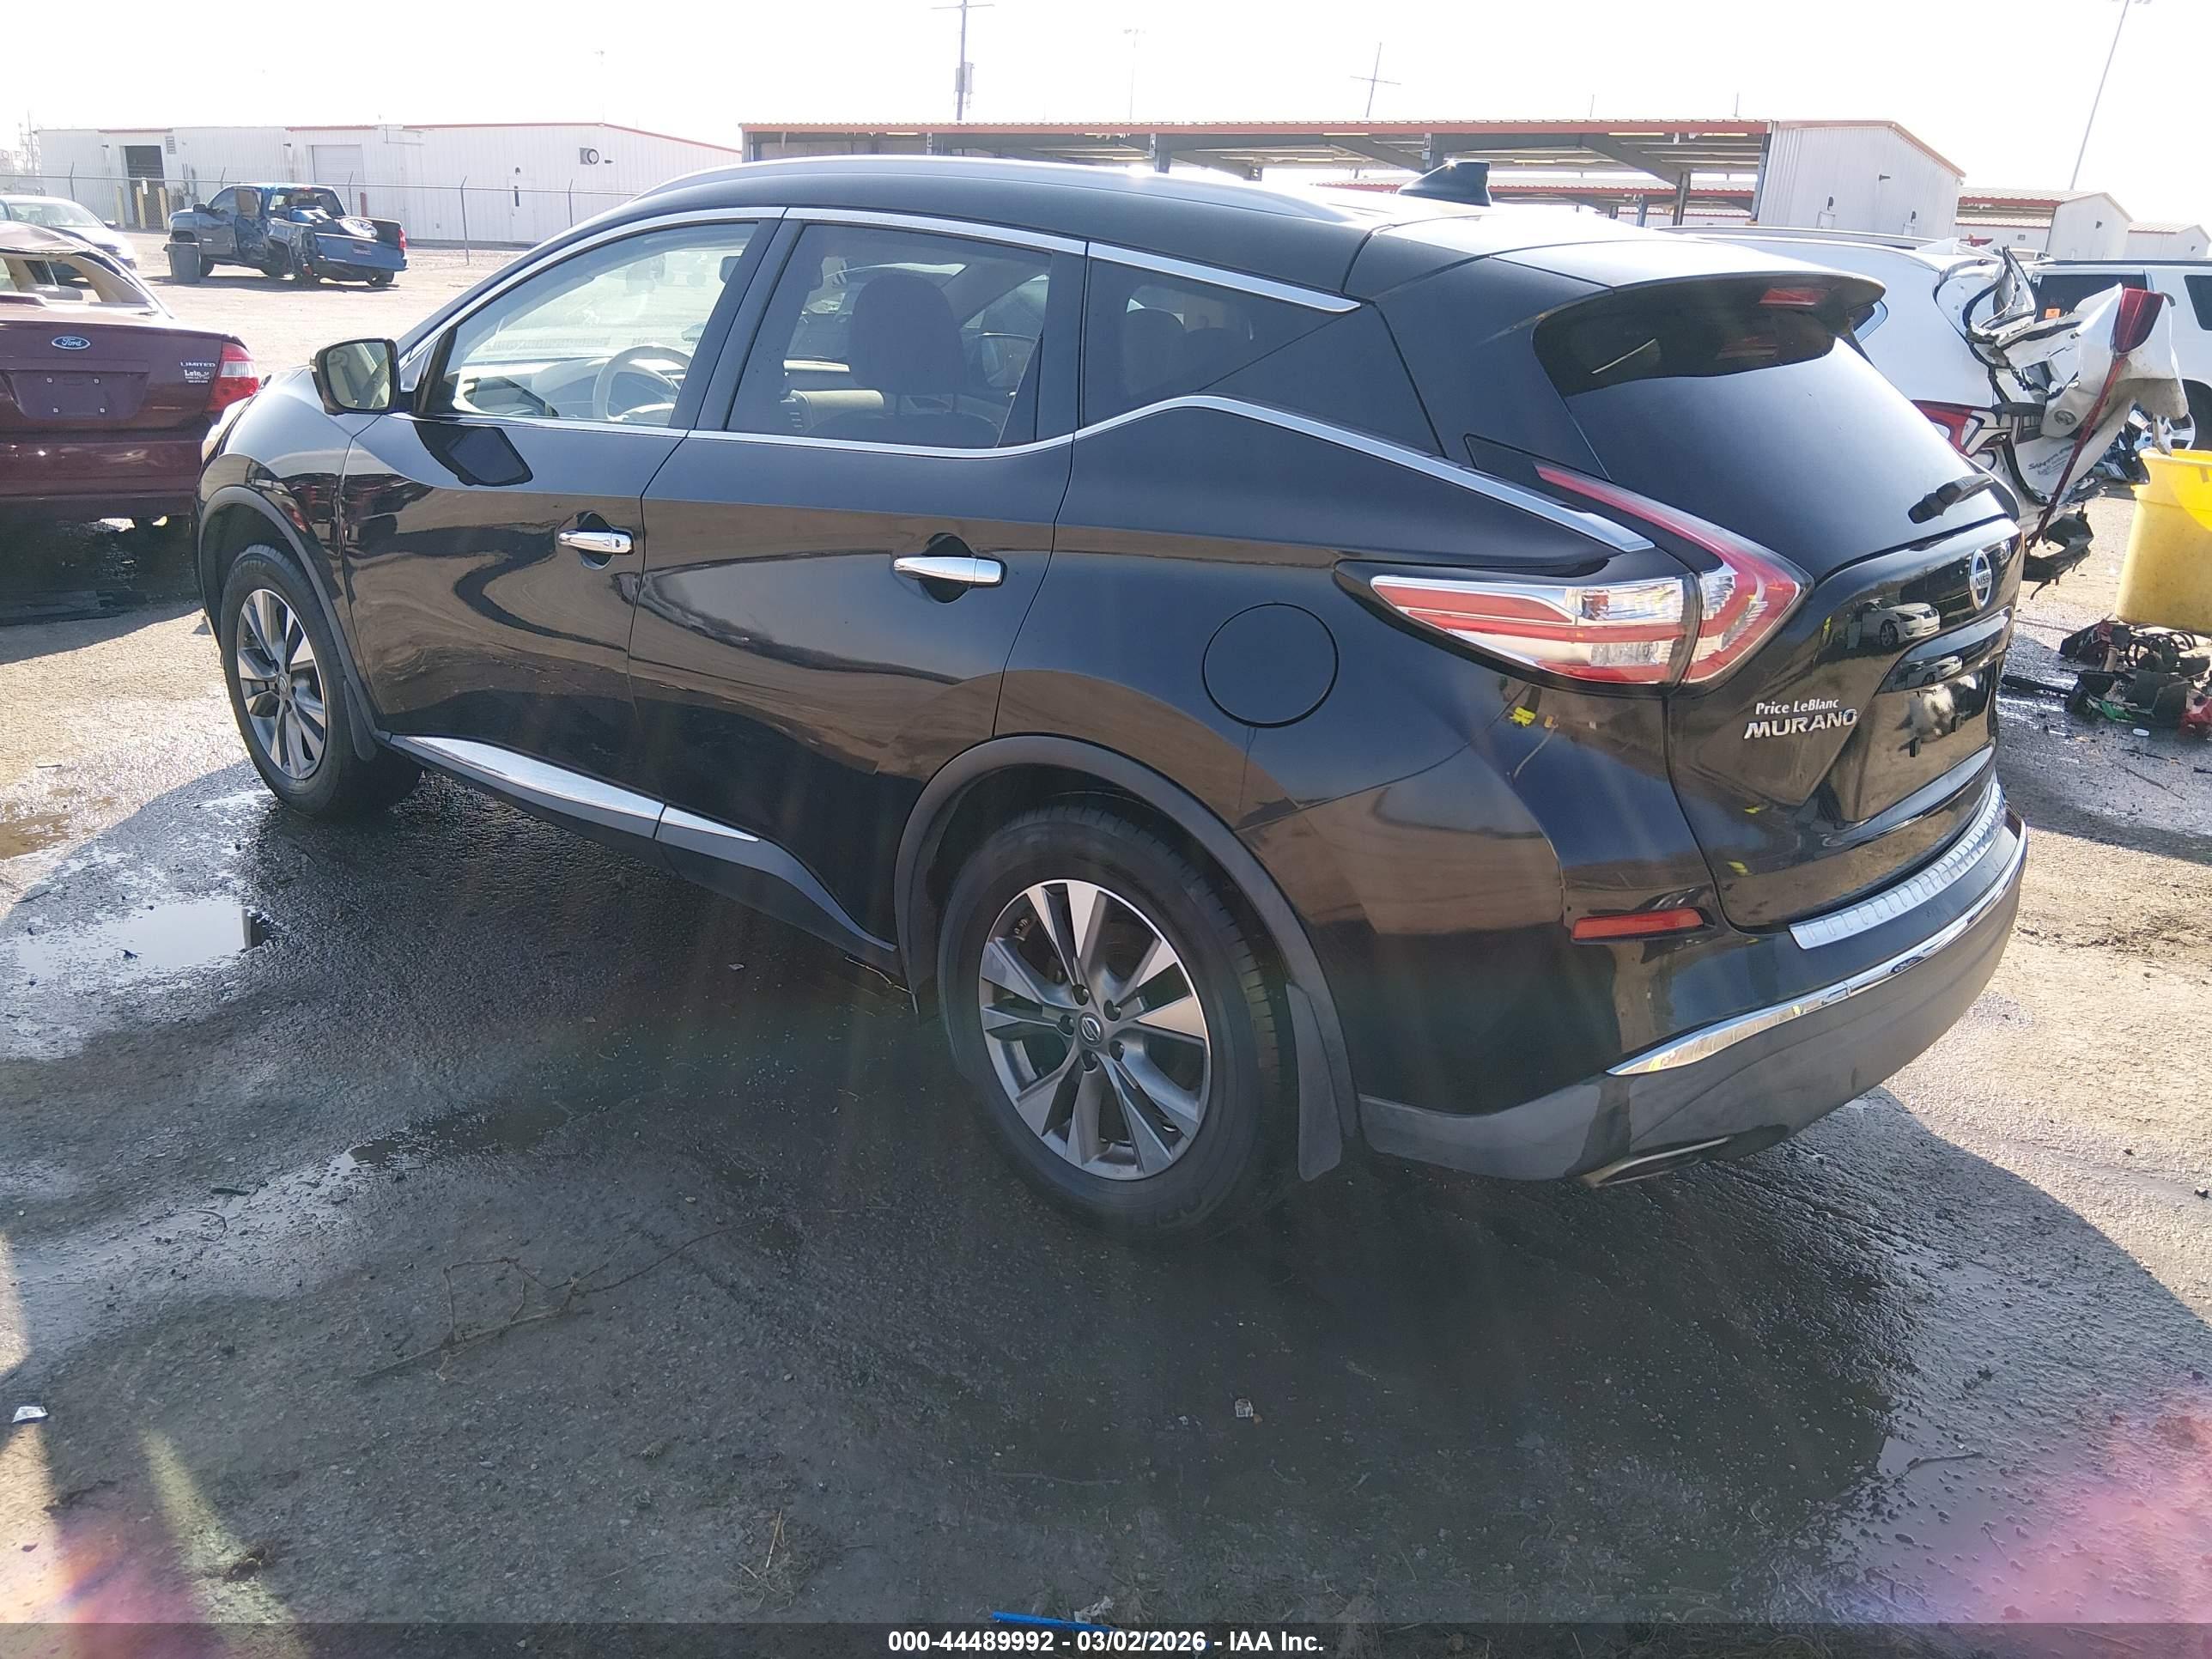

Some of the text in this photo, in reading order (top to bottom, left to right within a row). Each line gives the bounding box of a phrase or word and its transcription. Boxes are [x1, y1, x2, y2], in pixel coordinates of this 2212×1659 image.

[61, 337, 82, 347] Ford
[1755, 698, 1839, 715] Price LeBlanc
[1743, 708, 1857, 739] MURANO
